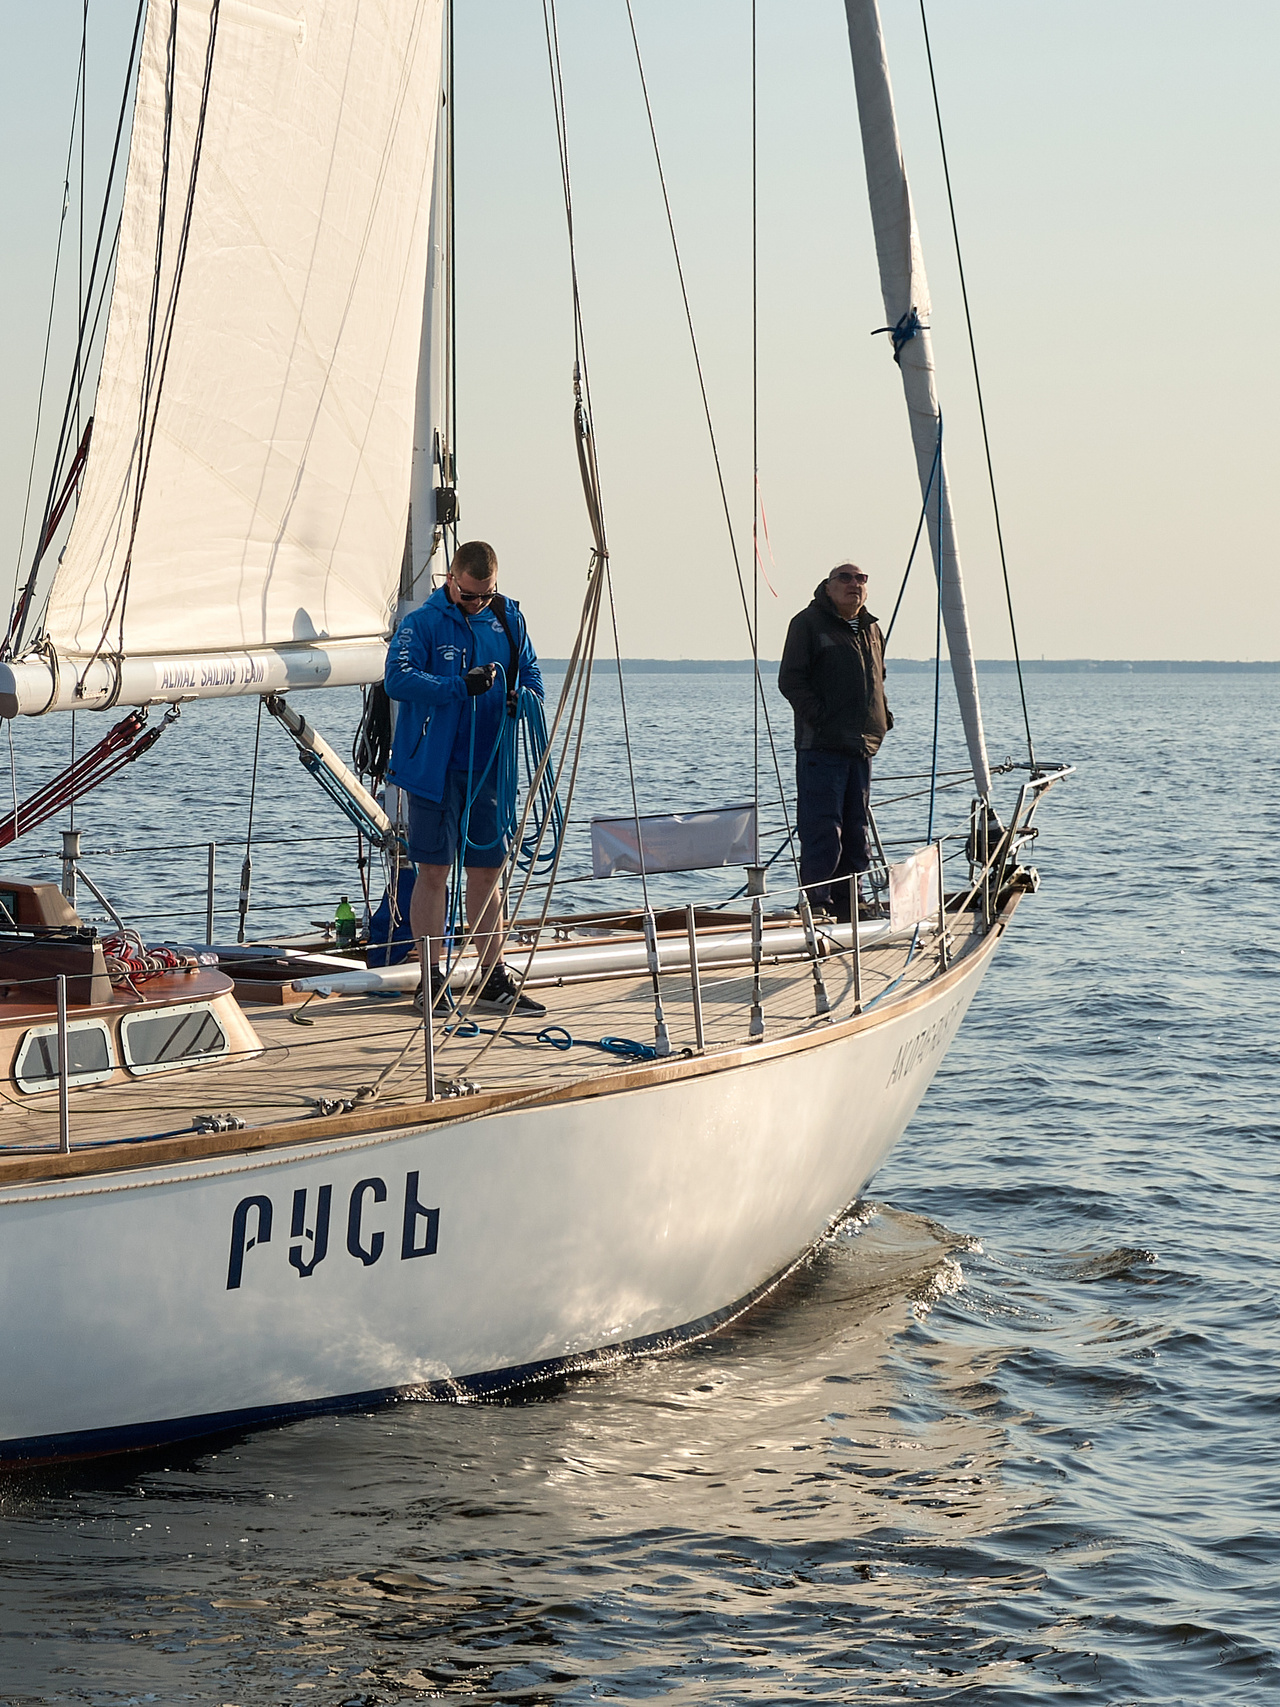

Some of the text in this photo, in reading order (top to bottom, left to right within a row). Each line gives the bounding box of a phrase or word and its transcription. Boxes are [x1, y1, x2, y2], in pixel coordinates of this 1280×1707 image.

[161, 660, 265, 689] ALMAZ SAILING TEAM
[226, 1170, 440, 1291] РУСЬ
